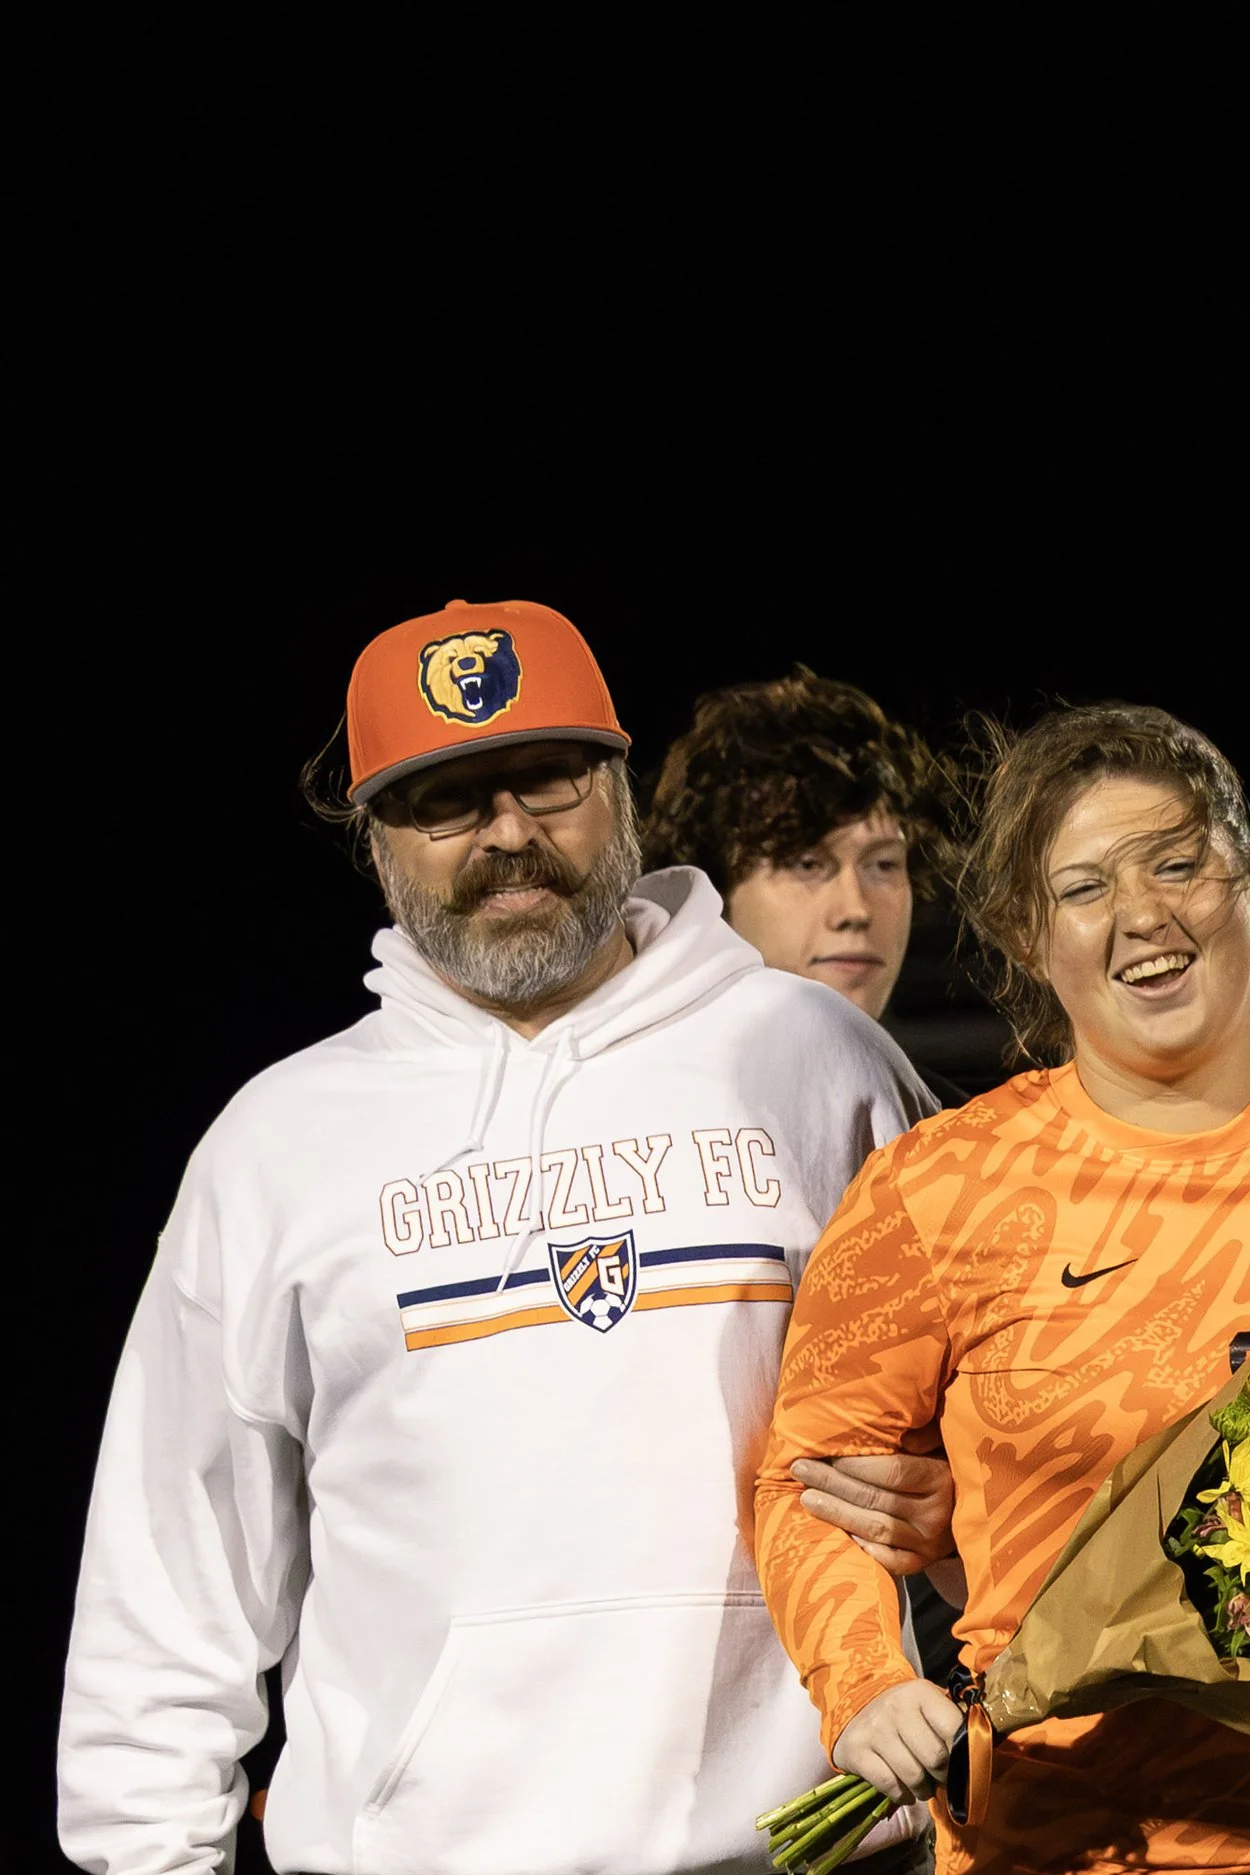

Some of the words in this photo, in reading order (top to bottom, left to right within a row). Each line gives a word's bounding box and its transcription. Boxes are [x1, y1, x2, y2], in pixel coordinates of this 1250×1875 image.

[379, 1133, 673, 1256] GRIZZLY
[691, 1127, 782, 1208] FC
[597, 1255, 625, 1296] G
